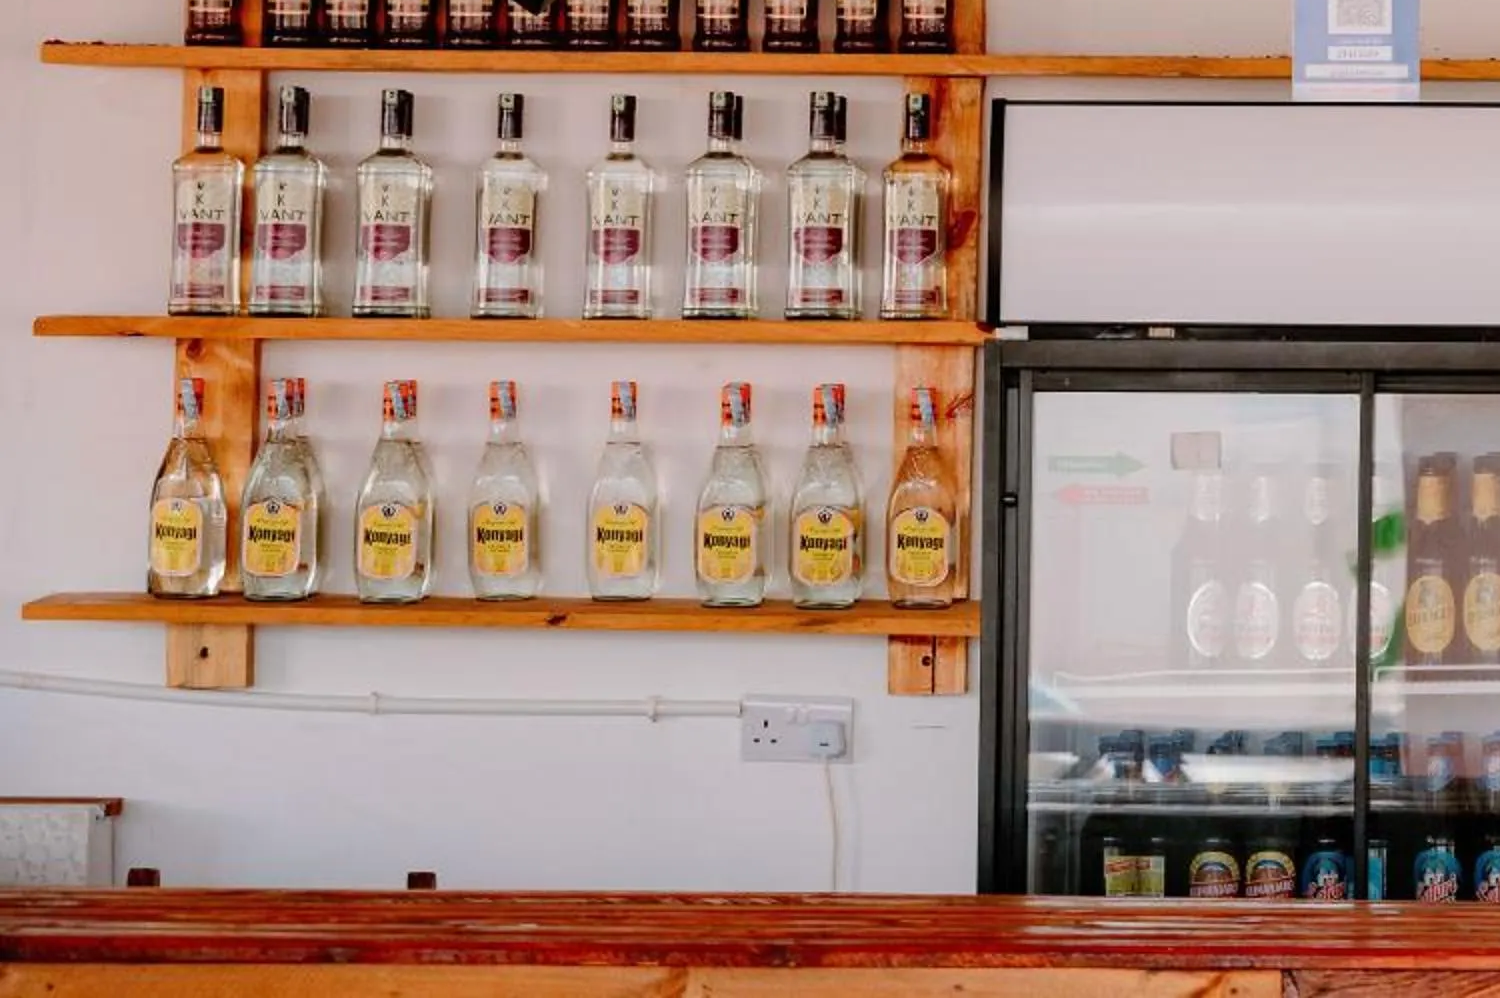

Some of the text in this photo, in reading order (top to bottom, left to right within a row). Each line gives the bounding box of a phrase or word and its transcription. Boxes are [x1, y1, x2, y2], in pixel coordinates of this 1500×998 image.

[179, 209, 225, 220] VANT
[260, 209, 306, 221] VANT
[364, 210, 411, 221] VANT
[593, 215, 639, 227] VANT
[155, 525, 197, 540] Konyagi
[247, 526, 295, 543] Konyagi
[364, 528, 412, 545] Konyagi
[476, 527, 524, 543] Konyagi
[596, 527, 643, 543] Konyagi
[703, 533, 751, 549] Konyagi
[800, 535, 848, 551] Konyagi
[897, 533, 945, 549] Konyagi
